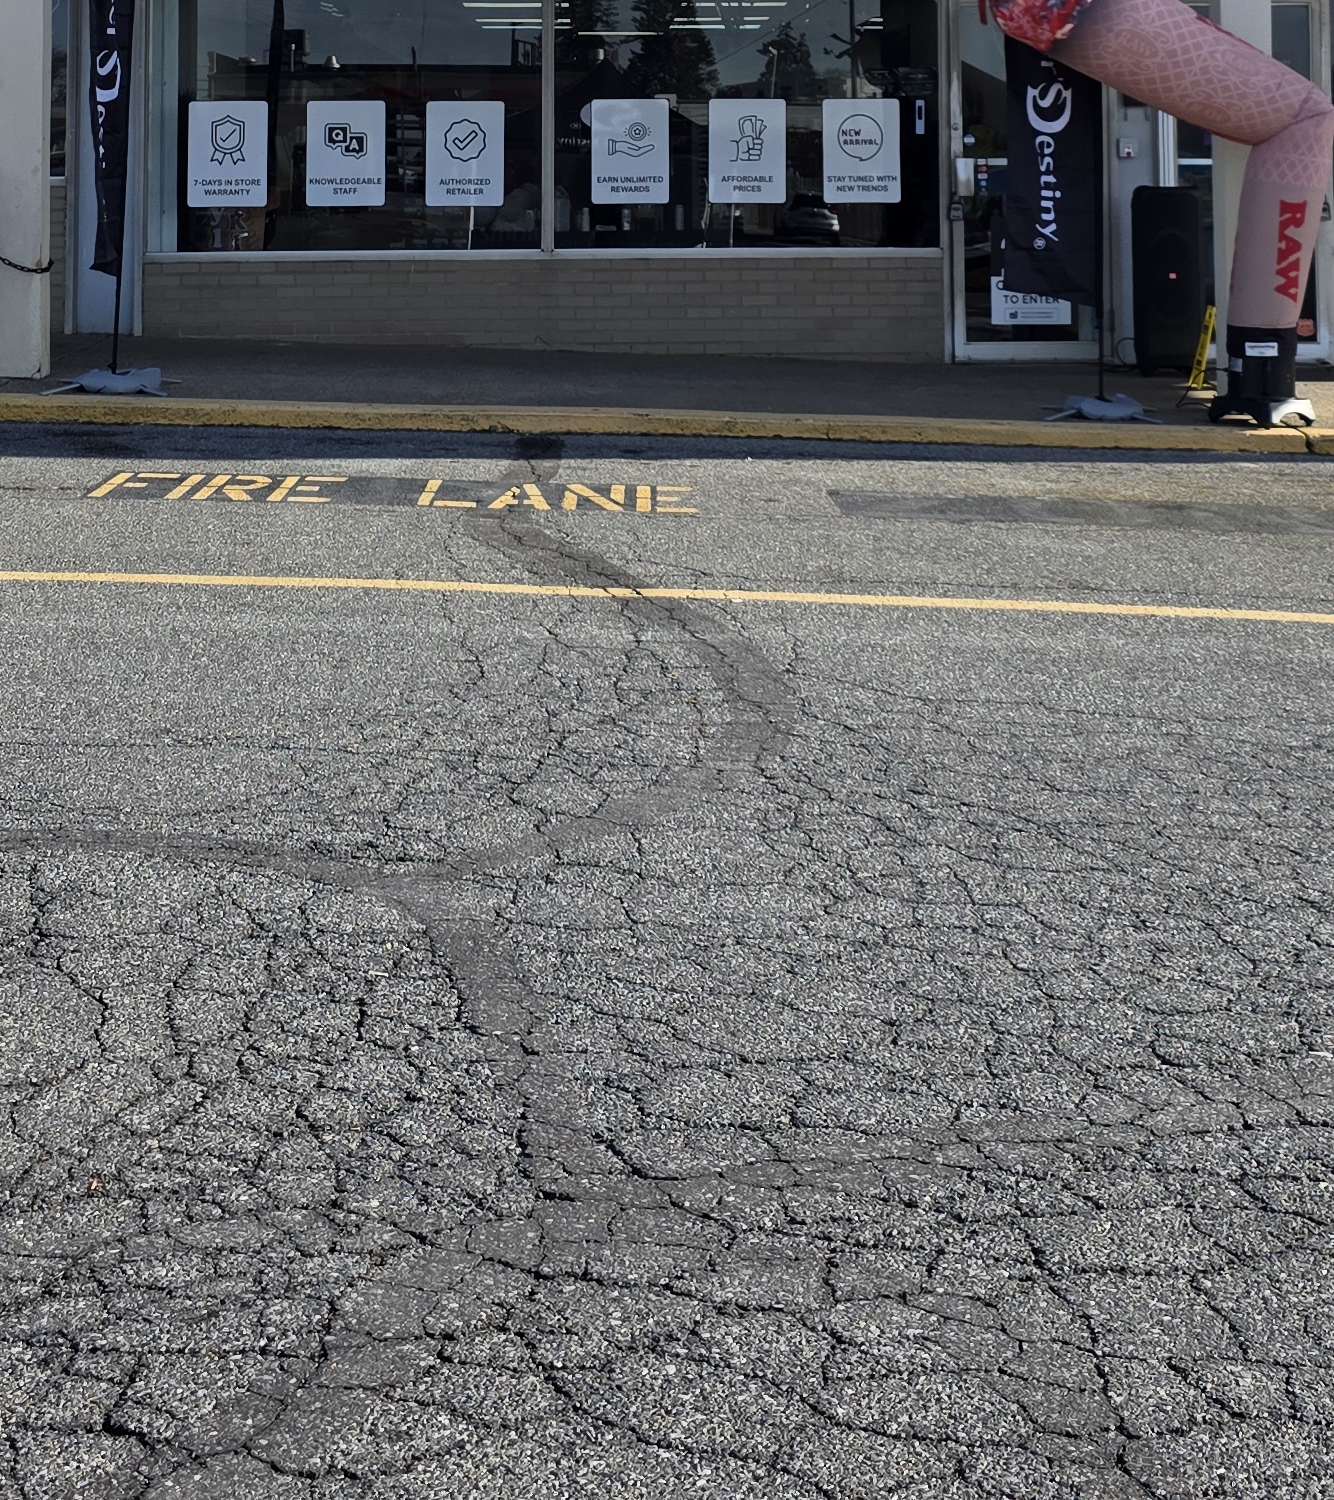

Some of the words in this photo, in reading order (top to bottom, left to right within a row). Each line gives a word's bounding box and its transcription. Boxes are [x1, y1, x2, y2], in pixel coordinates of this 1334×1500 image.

[333, 130, 343, 141] Q
[841, 129, 861, 138] NEW
[349, 139, 359, 150] A
[843, 138, 879, 147] ARRIVAL
[309, 177, 382, 185] KNOWLEDGEABLE
[439, 178, 491, 186] AUTHORIZED
[596, 176, 619, 184] EARN
[620, 175, 664, 183] UNLIMITED
[721, 175, 774, 183] AFFORDABLE
[827, 175, 847, 183] STAY
[848, 175, 875, 183] TUNED
[876, 175, 898, 183] WITH
[204, 188, 251, 196] WARRANTY
[332, 187, 358, 195] STAFF
[445, 187, 484, 195] RETAILER
[610, 185, 650, 193] REWARDS
[733, 184, 762, 192] PRICES
[836, 184, 855, 192] NEW
[856, 184, 889, 192] TRENDS
[1274, 199, 1307, 303] RAW
[1003, 295, 1019, 304] TO
[1022, 294, 1060, 304] ENTER
[86, 471, 350, 503] FIRE
[416, 478, 701, 515] LANE
